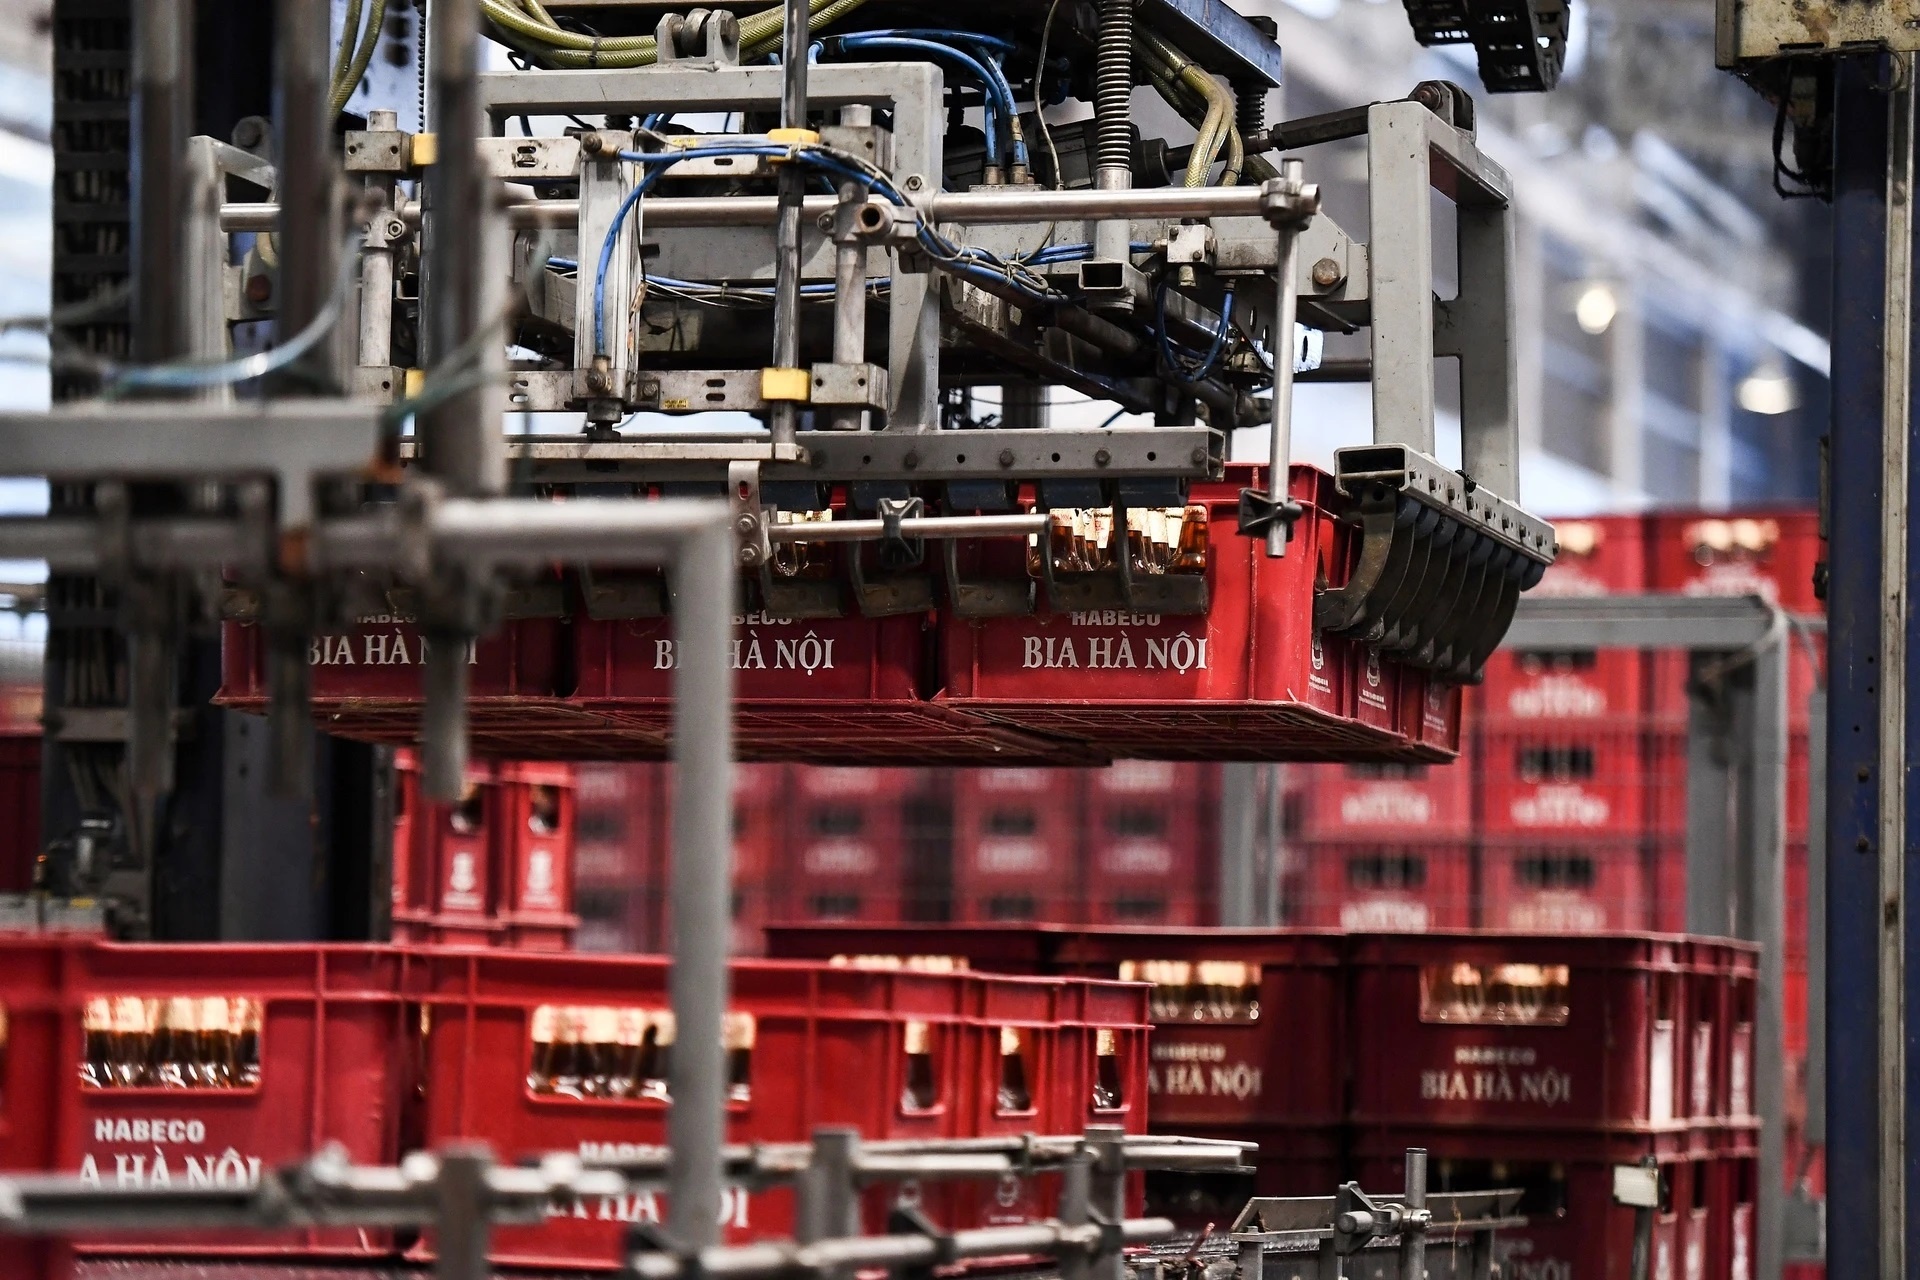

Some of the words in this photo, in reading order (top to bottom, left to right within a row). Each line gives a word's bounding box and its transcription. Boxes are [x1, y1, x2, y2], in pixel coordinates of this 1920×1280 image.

[363, 628, 411, 665] HÀ
[418, 635, 479, 665] NI
[774, 630, 835, 676] NỘI
[1022, 636, 1080, 669] BIA
[1087, 630, 1138, 669] HÀ
[1144, 631, 1208, 675] NỘI
[1421, 1069, 1469, 1100] BIA
[1473, 1065, 1515, 1101] HÀ
[94, 1118, 206, 1143] HABECO
